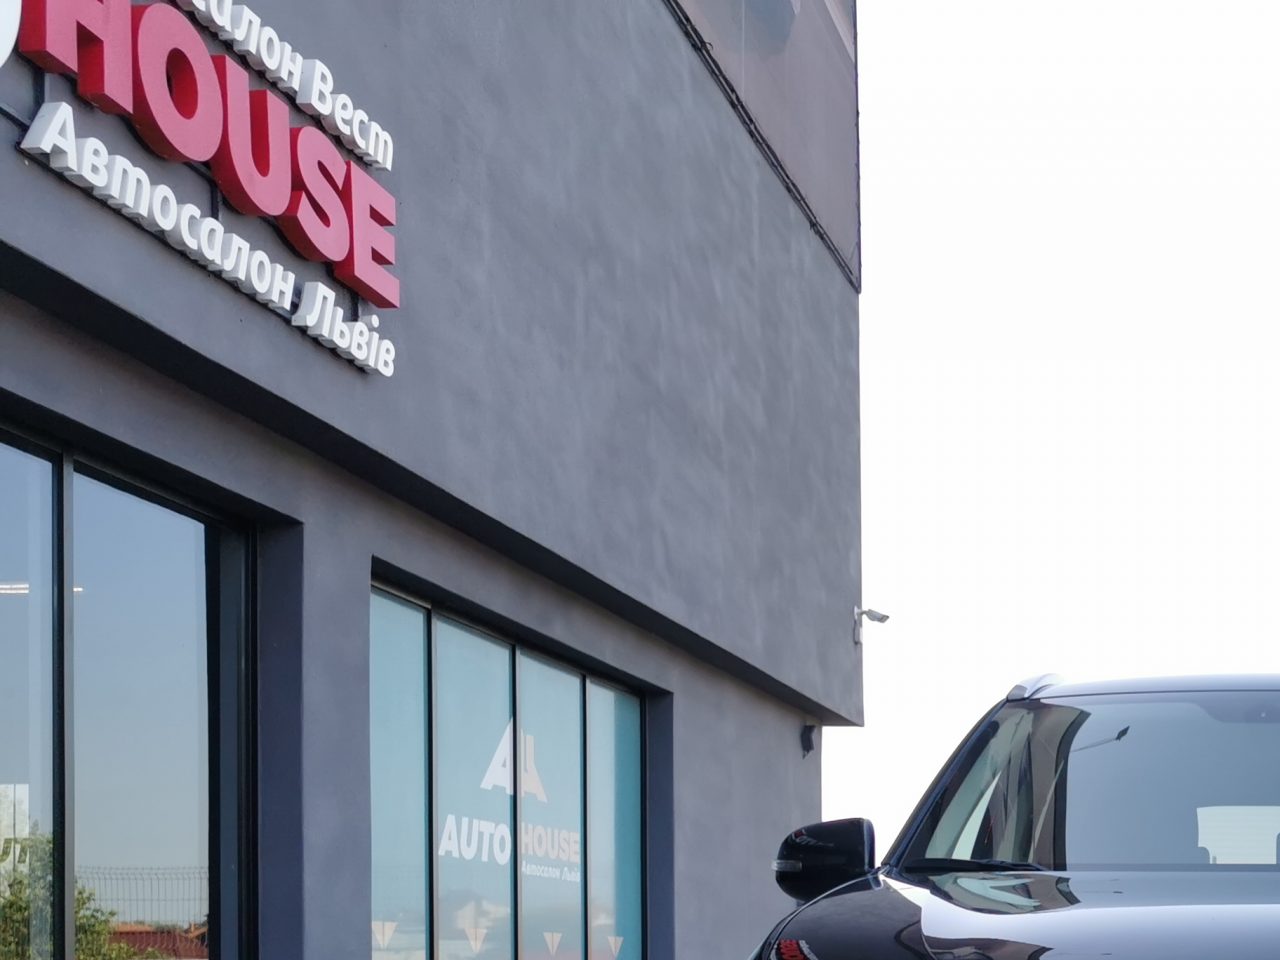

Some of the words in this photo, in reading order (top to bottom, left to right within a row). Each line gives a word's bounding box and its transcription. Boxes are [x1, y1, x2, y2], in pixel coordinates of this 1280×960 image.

[20, 0, 400, 308] HOUSE
[189, 0, 304, 92] алон
[298, 59, 393, 171] Вест
[22, 102, 295, 310] Автосалон
[293, 281, 396, 377] Львів
[438, 814, 512, 865] AUTO
[521, 822, 580, 864] HOUSE
